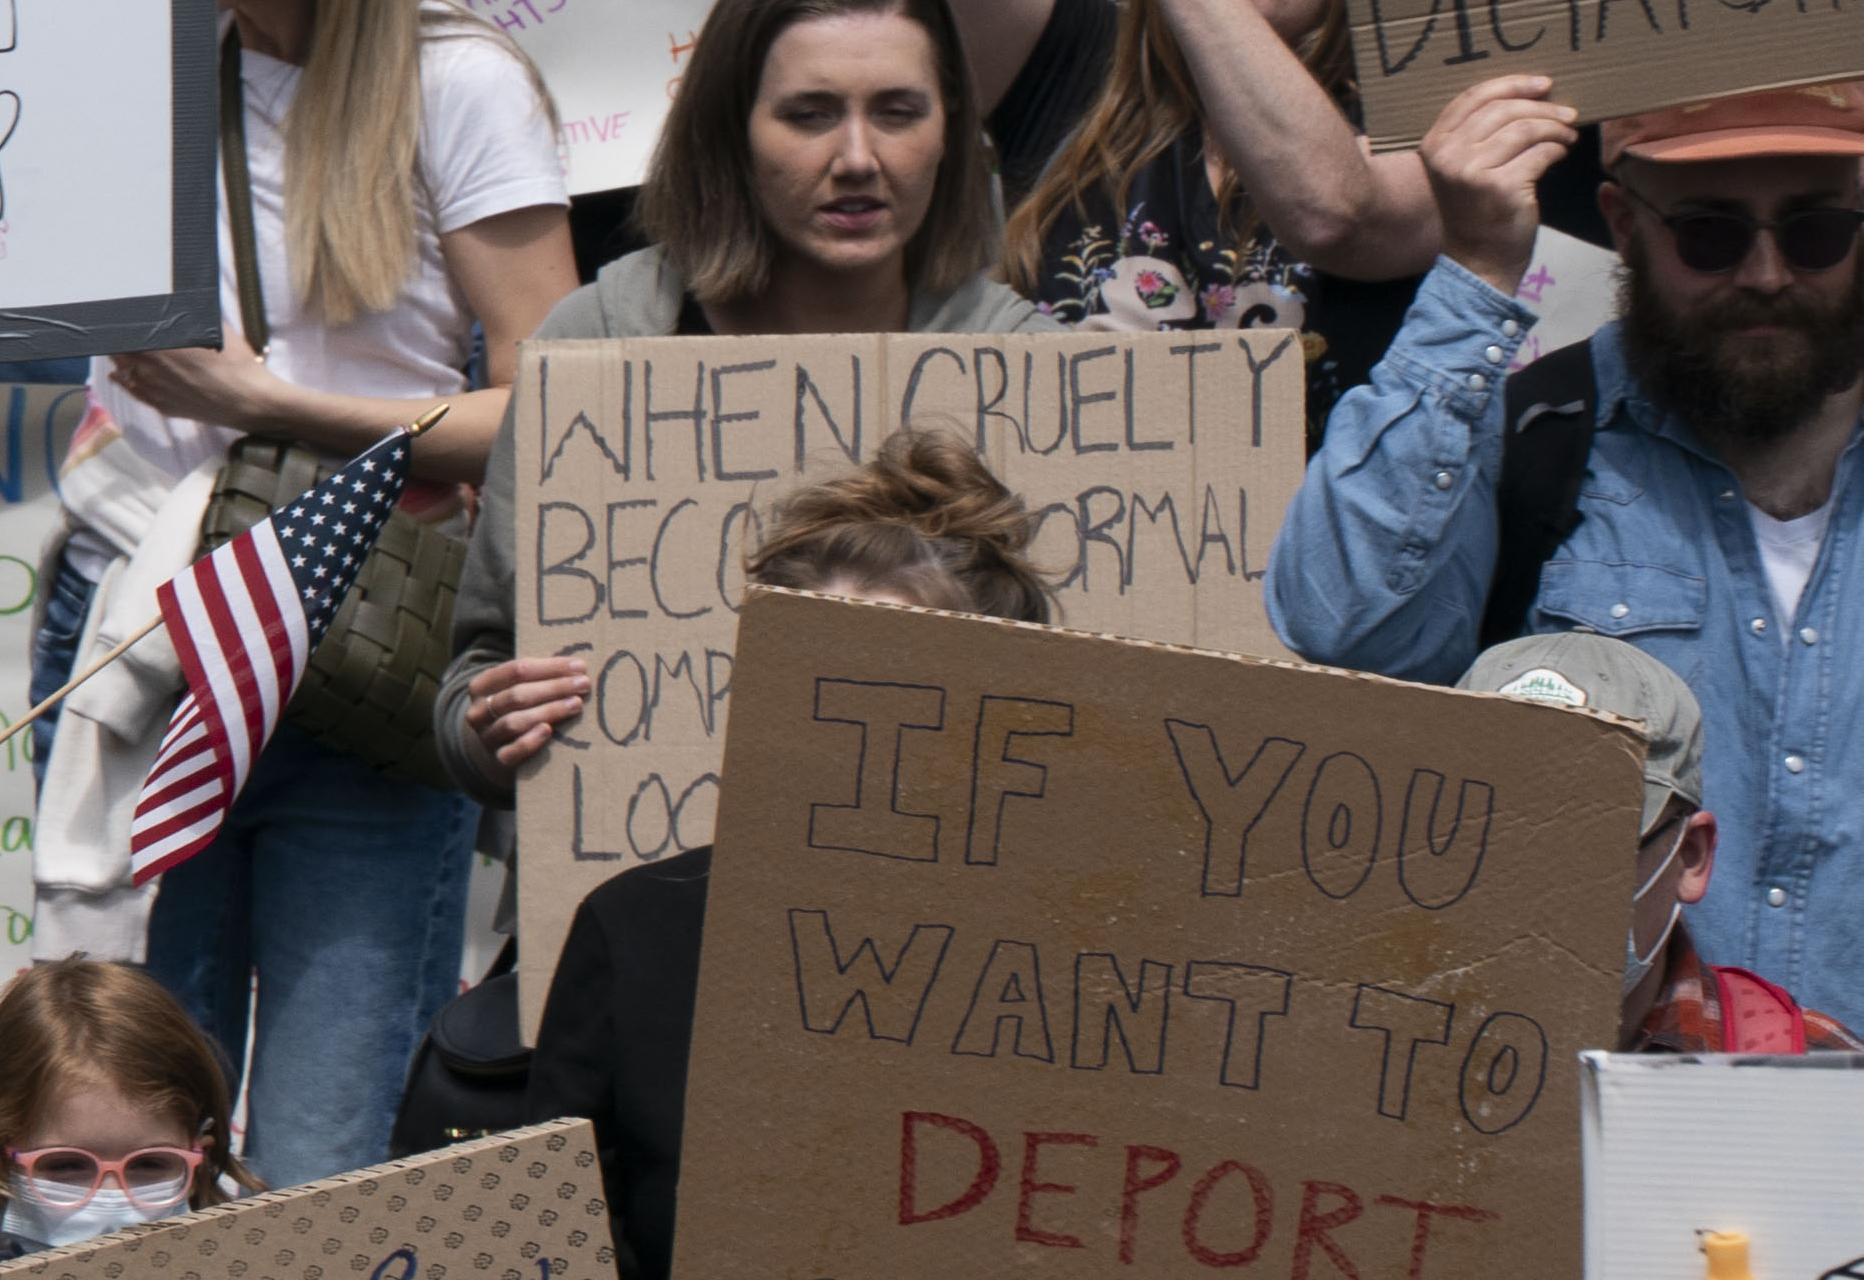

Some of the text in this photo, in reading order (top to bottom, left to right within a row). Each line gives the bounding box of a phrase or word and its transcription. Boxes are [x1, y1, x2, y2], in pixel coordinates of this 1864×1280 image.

[539, 333, 1295, 484] WHEN CRUELTY
[1036, 484, 1266, 596] ORMAL
[808, 676, 1496, 910] IF YOU
[787, 908, 1549, 1135] WANT TO
